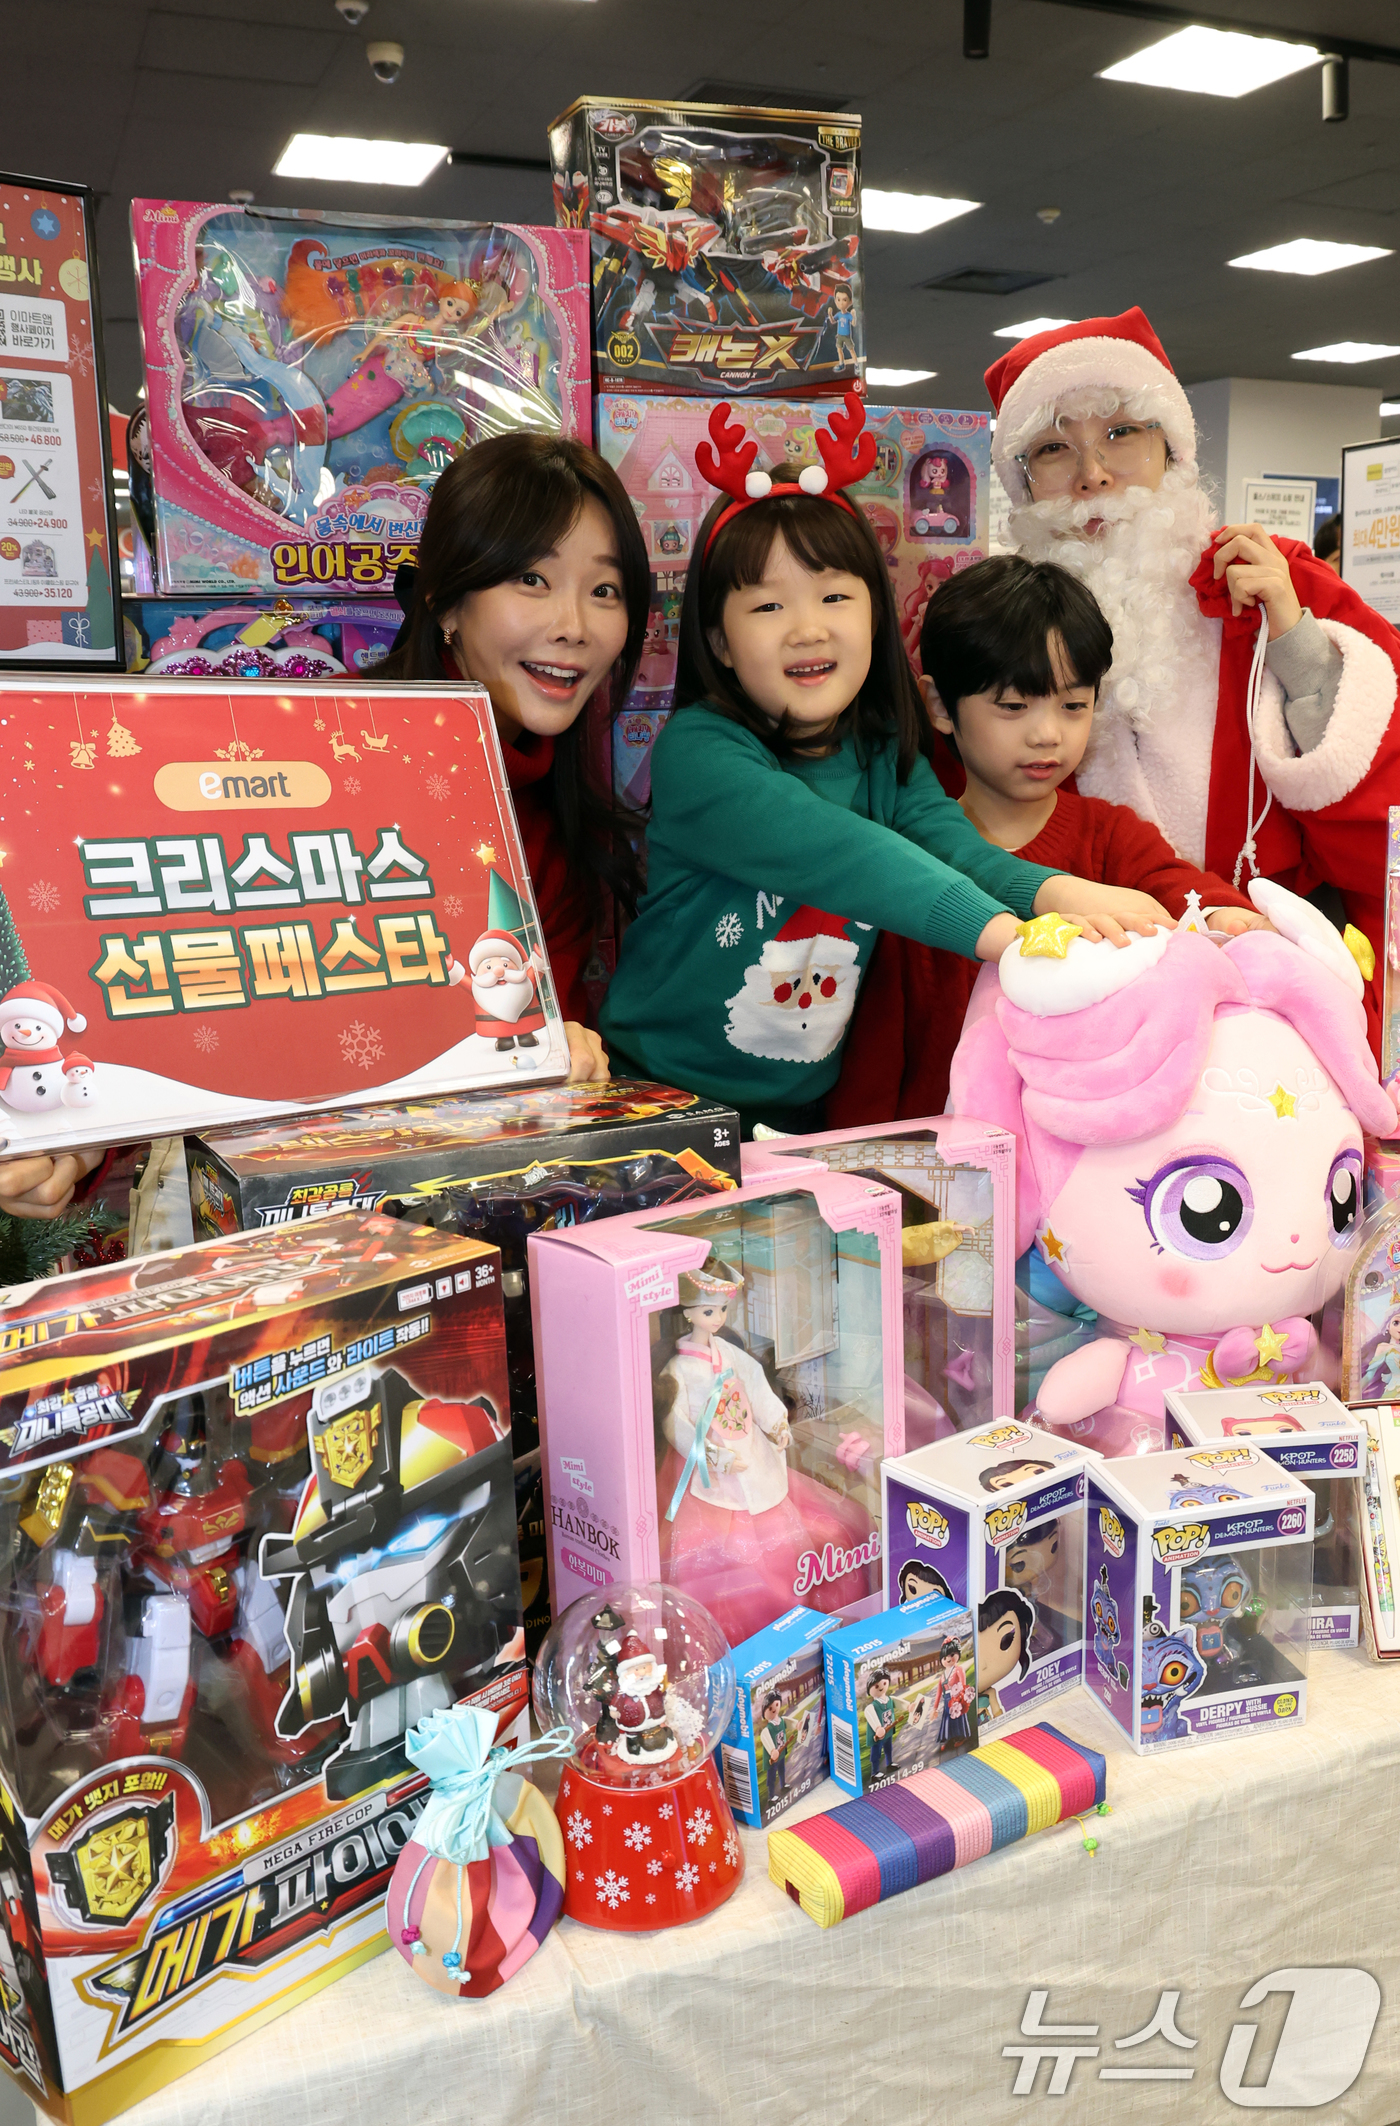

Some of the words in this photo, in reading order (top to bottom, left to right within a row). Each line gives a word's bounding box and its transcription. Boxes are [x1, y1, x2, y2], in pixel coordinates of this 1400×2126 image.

[10, 310, 52, 325] 이마트앱
[11, 322, 54, 336] 행사페이지
[12, 335, 54, 350] 바로가기
[614, 345, 633, 358] 002
[720, 371, 749, 379] CANNON
[31, 434, 61, 446] 46.800
[38, 518, 68, 529] 24.900
[315, 512, 385, 538] 물속에서
[1, 541, 18, 551] 20%
[44, 588, 73, 598] 35.120
[198, 771, 291, 799] emart
[82, 829, 433, 917] 크리스마스
[93, 912, 450, 1018] 선물페스타
[713, 1128, 730, 1141] 3+
[713, 1139, 731, 1148] AGES
[290, 1181, 354, 1205] 최강공룡
[475, 1264, 495, 1280] 36+
[475, 1276, 495, 1288] MONTH
[628, 1269, 660, 1294] Mimi
[642, 1286, 672, 1302] style
[234, 1353, 287, 1389] 버튼을
[289, 1336, 331, 1368] 누르면
[239, 1382, 272, 1409] 액션
[274, 1353, 343, 1396] 사운드와
[346, 1328, 395, 1366] 라이트
[395, 1315, 430, 1343] 작동!!
[36, 1395, 62, 1415] 최강
[1257, 1390, 1320, 1404] POP!
[14, 1396, 128, 1453] 미니특공대
[1317, 1420, 1346, 1428] Funko
[967, 1425, 1025, 1448] POP!
[1338, 1434, 1359, 1442] NETFLIX
[1054, 1449, 1079, 1461] Funko
[1186, 1448, 1250, 1468] POP!
[1333, 1448, 1354, 1464] 2258
[562, 1459, 585, 1472] Mimi
[571, 1476, 593, 1493] style
[1260, 1483, 1291, 1492] Funko
[1286, 1498, 1307, 1506] NETFLIX
[906, 1501, 949, 1540] POP!
[984, 1500, 1028, 1540] POP!
[1099, 1506, 1125, 1548] POP!
[1281, 1512, 1303, 1530] 2260
[551, 1506, 622, 1562] HANBOK
[1151, 1523, 1210, 1557] POP!
[794, 1532, 883, 1596] Mimi
[1162, 1550, 1200, 1563] ANIMATION
[568, 1554, 606, 1585] 한복미미
[851, 1638, 883, 1655] 72015
[860, 1641, 911, 1675] playmobil
[743, 1660, 773, 1679] 72015
[755, 1658, 797, 1699] playmobil
[826, 1653, 835, 1686] 72015
[1036, 1661, 1061, 1683] ZOEY
[842, 1659, 854, 1712] playmobil
[736, 1686, 750, 1738] playmobil
[1200, 1701, 1243, 1722] DERPY
[1246, 1698, 1262, 1706] WITH
[1208, 1718, 1226, 1726] FIGURES
[1257, 1709, 1271, 1717] VINYLE
[1245, 1703, 1267, 1713] SUSSIE
[122, 1771, 168, 1794] 포함!!
[868, 1775, 897, 1792] 72015
[901, 1760, 925, 1778] 4-99
[765, 1796, 789, 1820] 72015
[793, 1777, 811, 1798] 4-99
[262, 1842, 304, 1871] MEGA
[307, 1821, 344, 1847] FIRE
[345, 1803, 374, 1826] COP
[127, 1885, 266, 2022] 메가
[269, 1795, 430, 1929] 파이어
